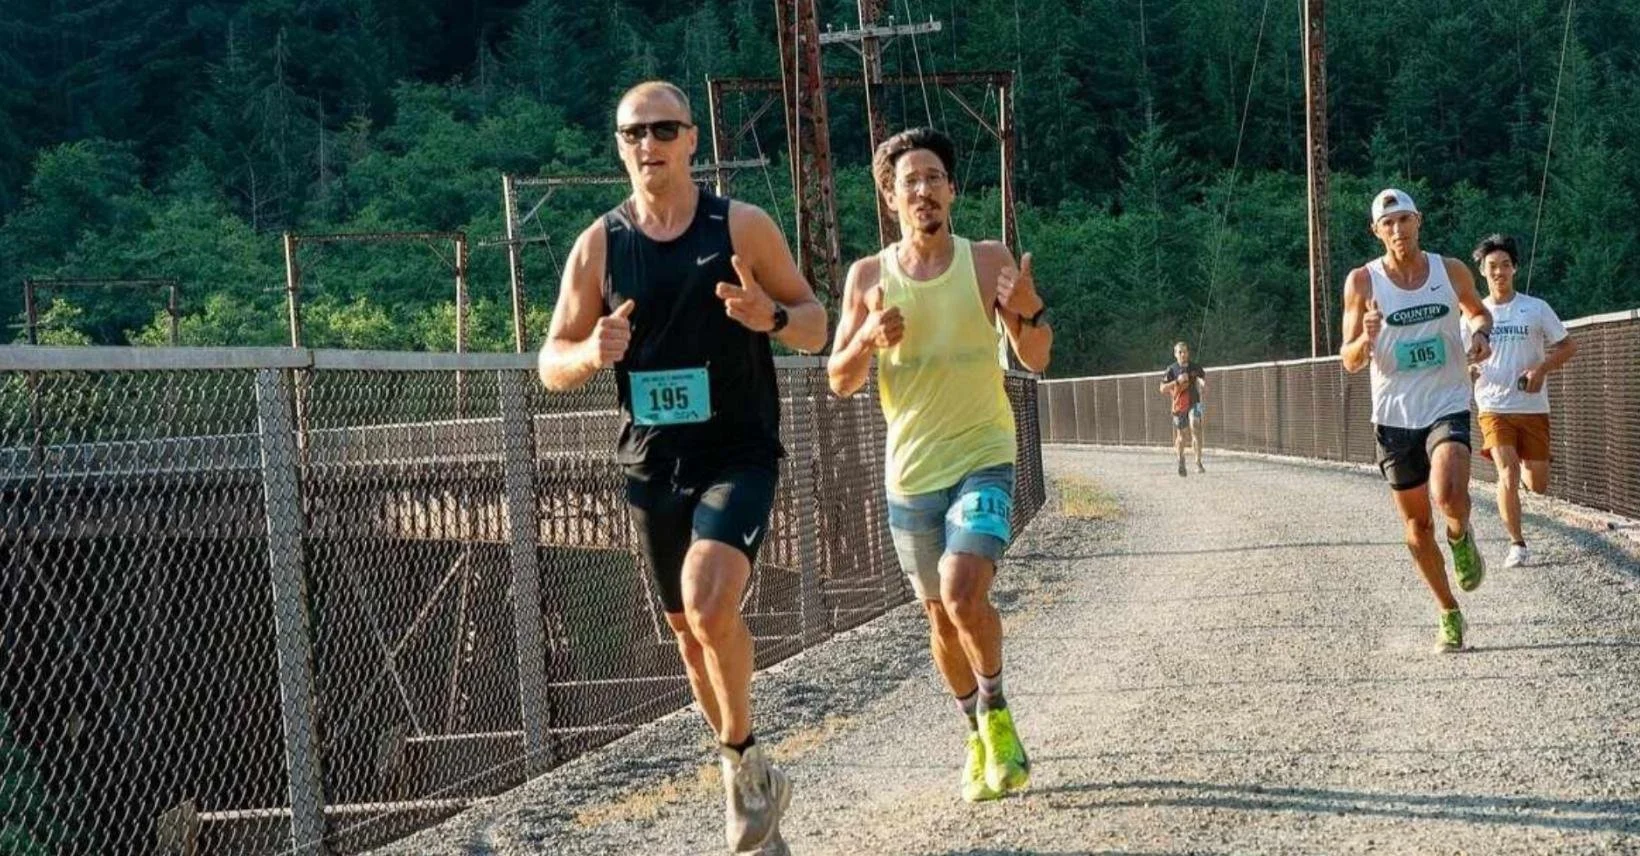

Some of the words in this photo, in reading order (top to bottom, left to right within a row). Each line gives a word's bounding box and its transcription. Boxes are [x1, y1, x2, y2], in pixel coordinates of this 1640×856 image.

[1393, 305, 1442, 321] COUNTRY
[1489, 325, 1529, 335] ODINVILLE
[1409, 346, 1436, 363] 105
[649, 386, 689, 411] 195
